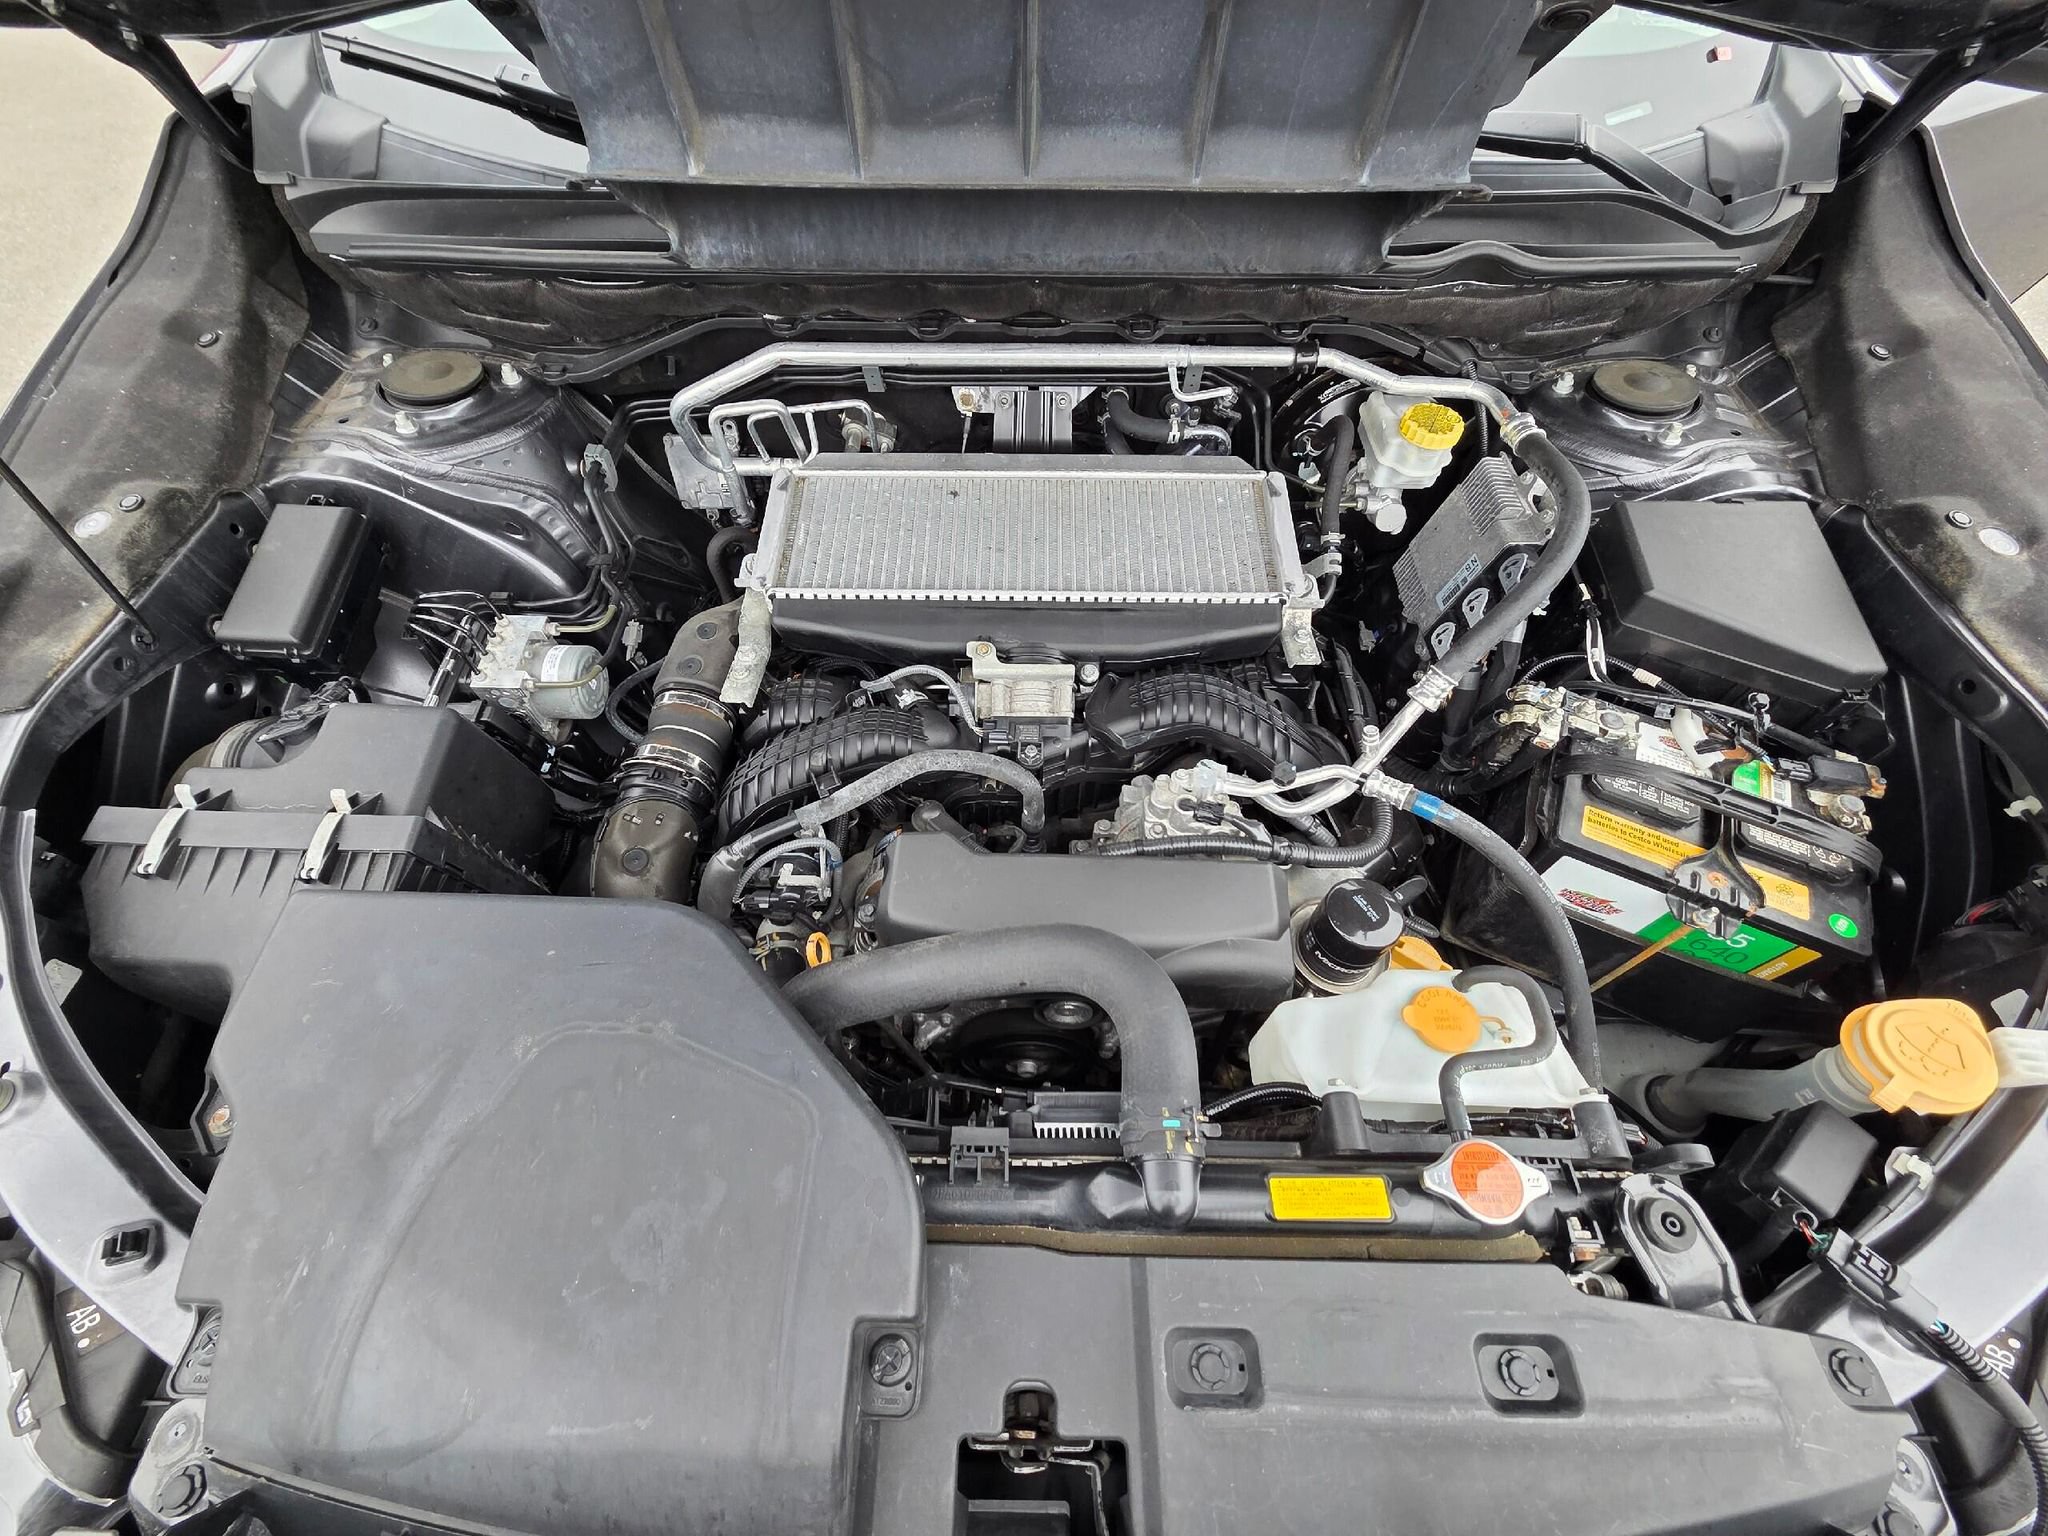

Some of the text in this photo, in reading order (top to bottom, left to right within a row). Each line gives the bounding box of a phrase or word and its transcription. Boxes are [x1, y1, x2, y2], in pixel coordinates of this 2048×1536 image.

[1587, 816, 1619, 834] batteries
[1628, 831, 1652, 846] Costco
[1588, 809, 1680, 848] Return warranty and used
[1689, 938, 1748, 964] 640
[66, 1305, 100, 1334] AB
[1983, 1345, 2014, 1379] AB
